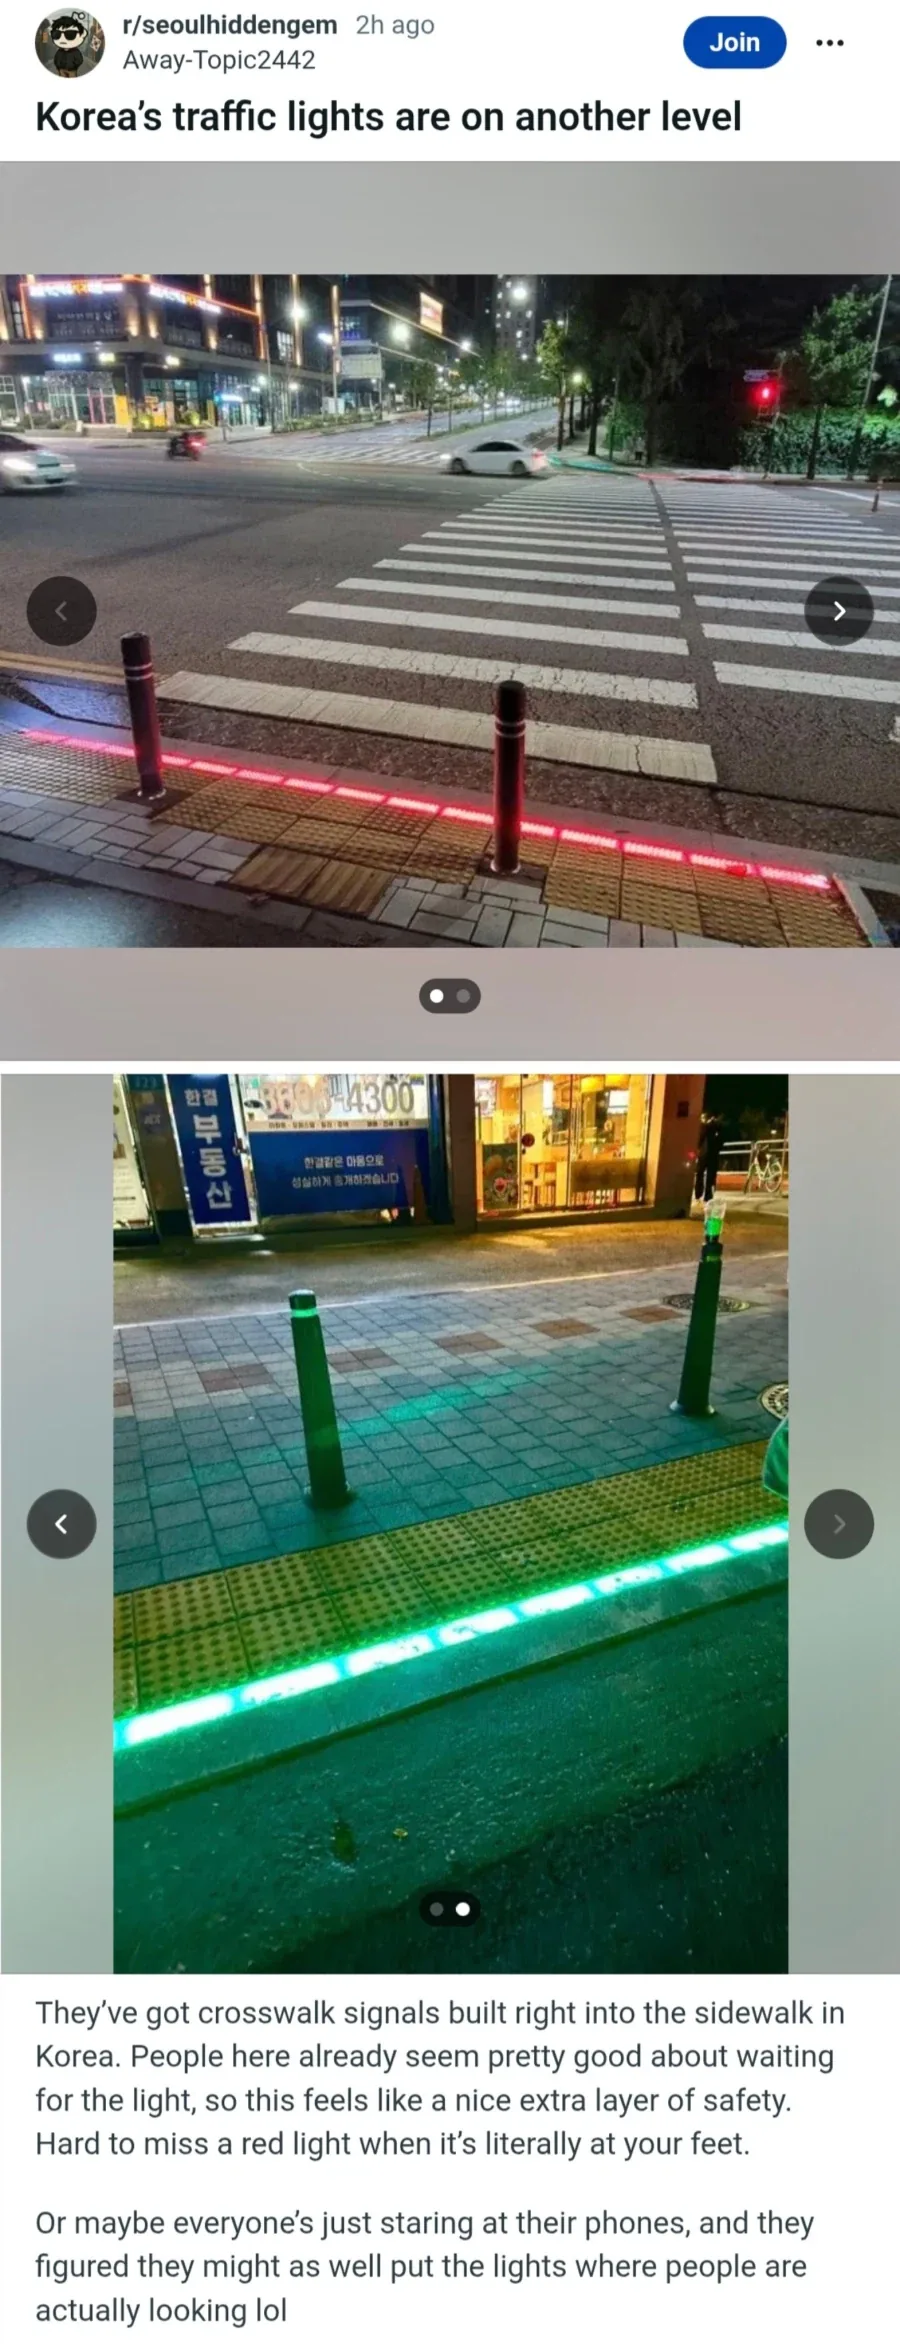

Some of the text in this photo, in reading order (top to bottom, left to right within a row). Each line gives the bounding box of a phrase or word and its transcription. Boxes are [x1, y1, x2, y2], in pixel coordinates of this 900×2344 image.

[184, 1088, 219, 1107] 한결
[193, 1114, 233, 1210] 부동산
[303, 1154, 385, 1169] 한결같은 마음으로
[291, 1175, 332, 1189] 성실하게
